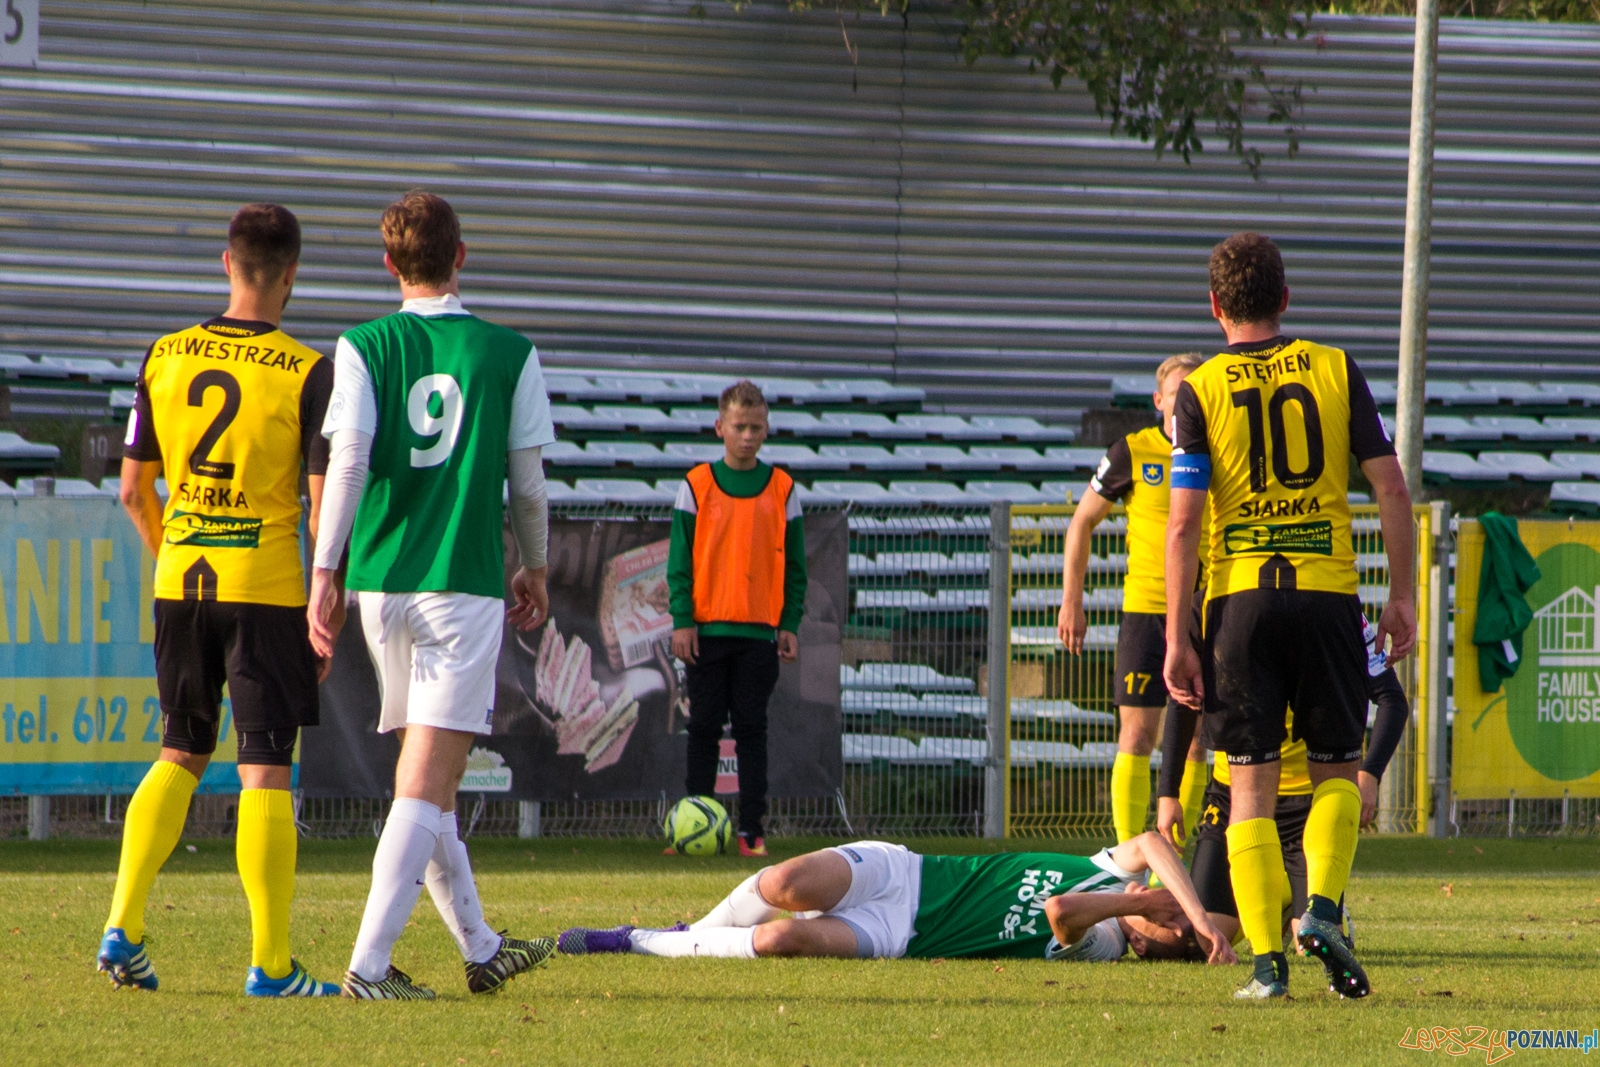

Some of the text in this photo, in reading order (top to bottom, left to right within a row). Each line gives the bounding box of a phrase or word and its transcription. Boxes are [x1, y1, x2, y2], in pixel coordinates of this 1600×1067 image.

[207, 324, 256, 336] SIARKOWCY
[155, 336, 304, 374] SYLWESTRZAK
[1225, 349, 1311, 384] STĘPIEŃ
[187, 369, 242, 480] 2
[407, 373, 465, 468] 9
[1231, 382, 1325, 494] 10
[1238, 497, 1321, 518] SIARKA
[1124, 671, 1152, 695] 17
[2, 694, 58, 744] tel.
[73, 695, 128, 744] 602
[1538, 698, 1600, 723] HOUSE
